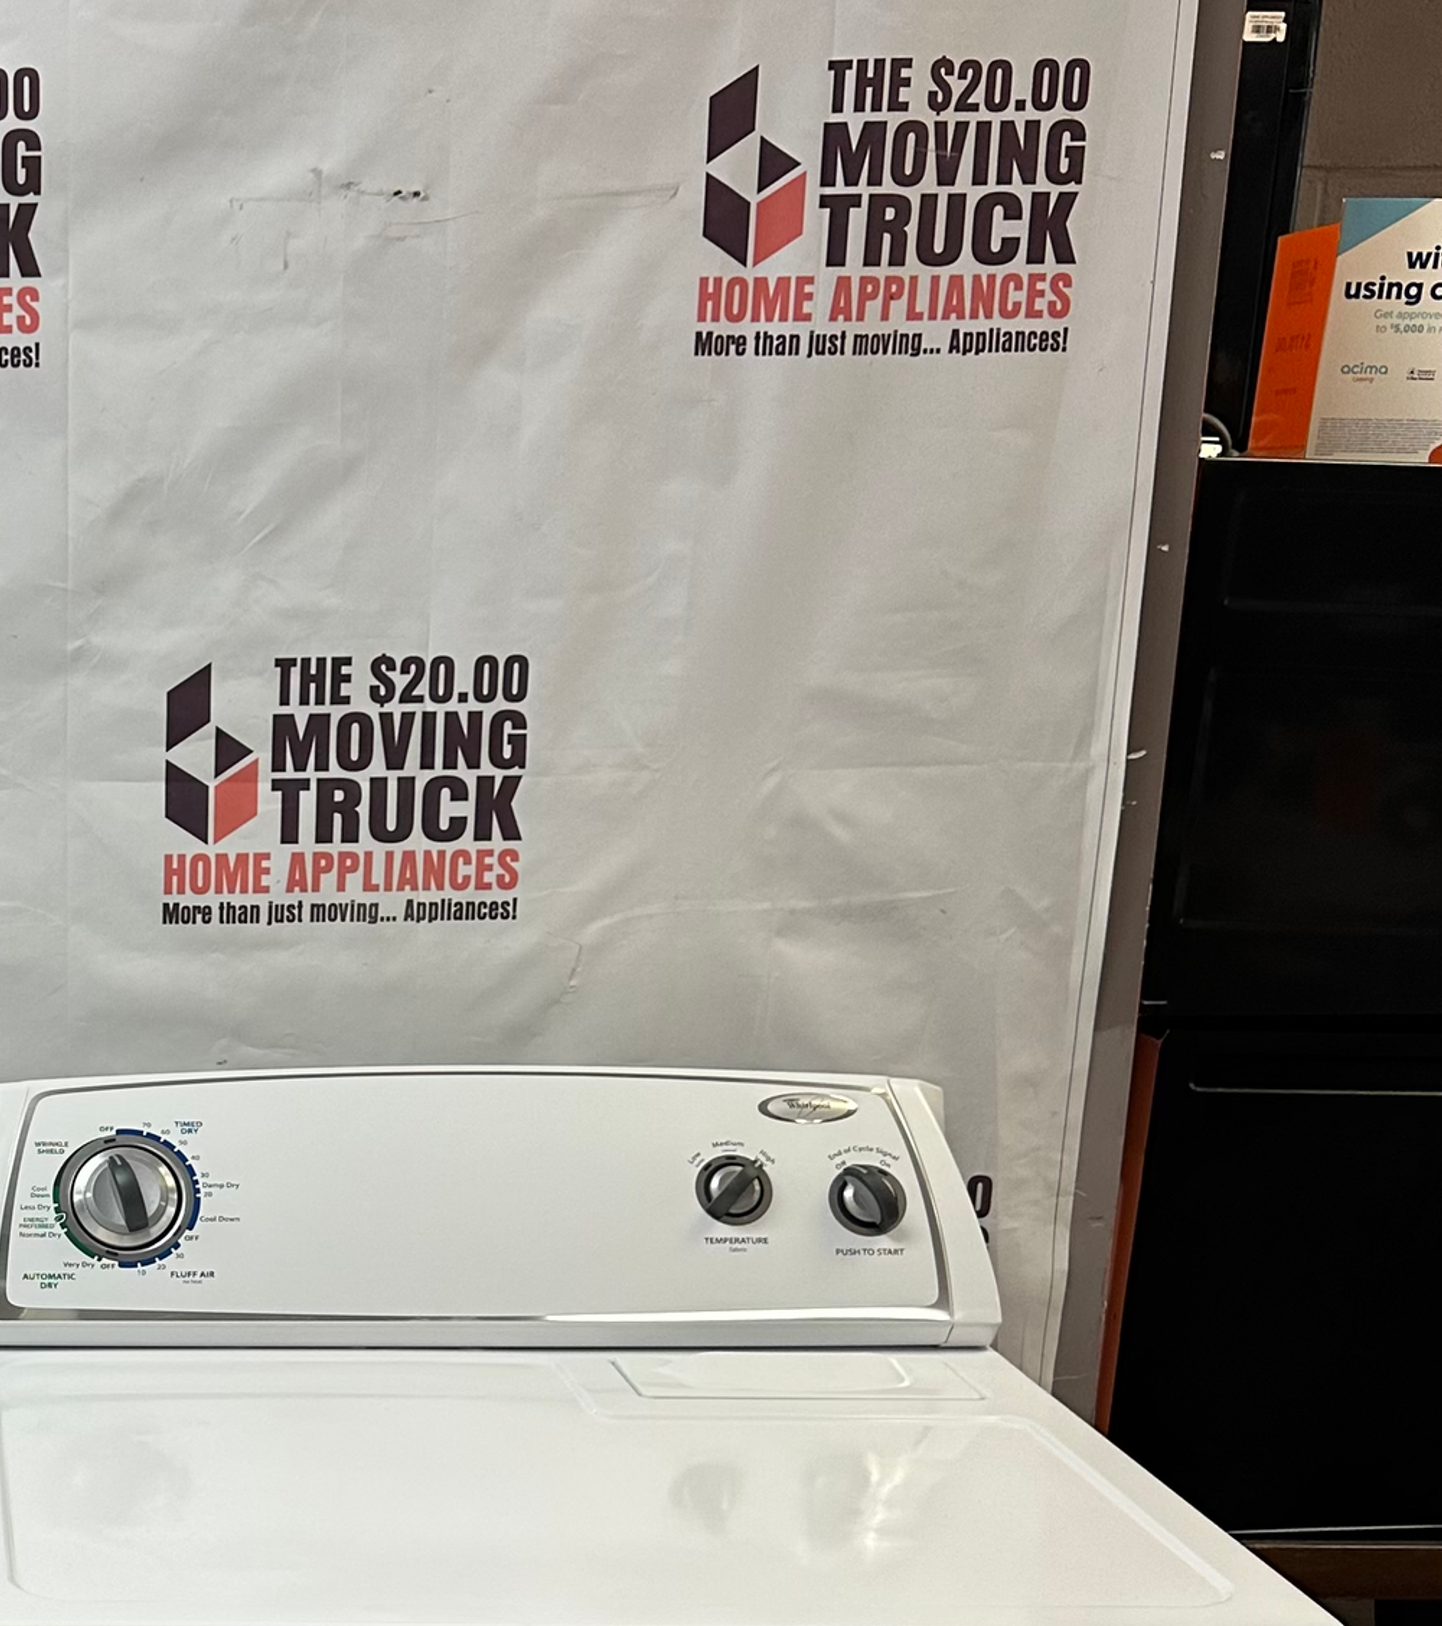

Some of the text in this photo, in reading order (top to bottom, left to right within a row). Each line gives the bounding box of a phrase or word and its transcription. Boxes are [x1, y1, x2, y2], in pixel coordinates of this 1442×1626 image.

[828, 55, 1090, 116] THE $20.00
[820, 119, 1086, 187] MOVING
[819, 192, 1079, 267] TRUCK
[1344, 275, 1424, 306] using
[698, 273, 1073, 323] HOME APPLIANCES
[1374, 308, 1394, 320] Get
[1375, 324, 1387, 334] to
[694, 327, 1068, 358] More than just moving... Appliances!
[1340, 362, 1389, 375] acima
[275, 654, 529, 707] THE $20.00
[271, 710, 527, 772] MOVING
[271, 775, 522, 844] TRUCK
[165, 849, 519, 894] HOME APPLIANCES
[162, 898, 517, 925] More than just moving... Appliances!
[783, 1098, 831, 1111] Whirlpool
[712, 1140, 745, 1148] Medium
[828, 1150, 842, 1161] End
[843, 1146, 852, 1154] of
[876, 1147, 900, 1162] Signal
[202, 1182, 240, 1190] Damp Dry
[37, 1204, 51, 1212] Dry
[704, 1237, 770, 1245] TEMPERATURE
[836, 1248, 906, 1256] PUSH TO START
[81, 1261, 96, 1269] Dry
[22, 1272, 76, 1280] AUTOMATIC
[40, 1282, 59, 1290] DRY
